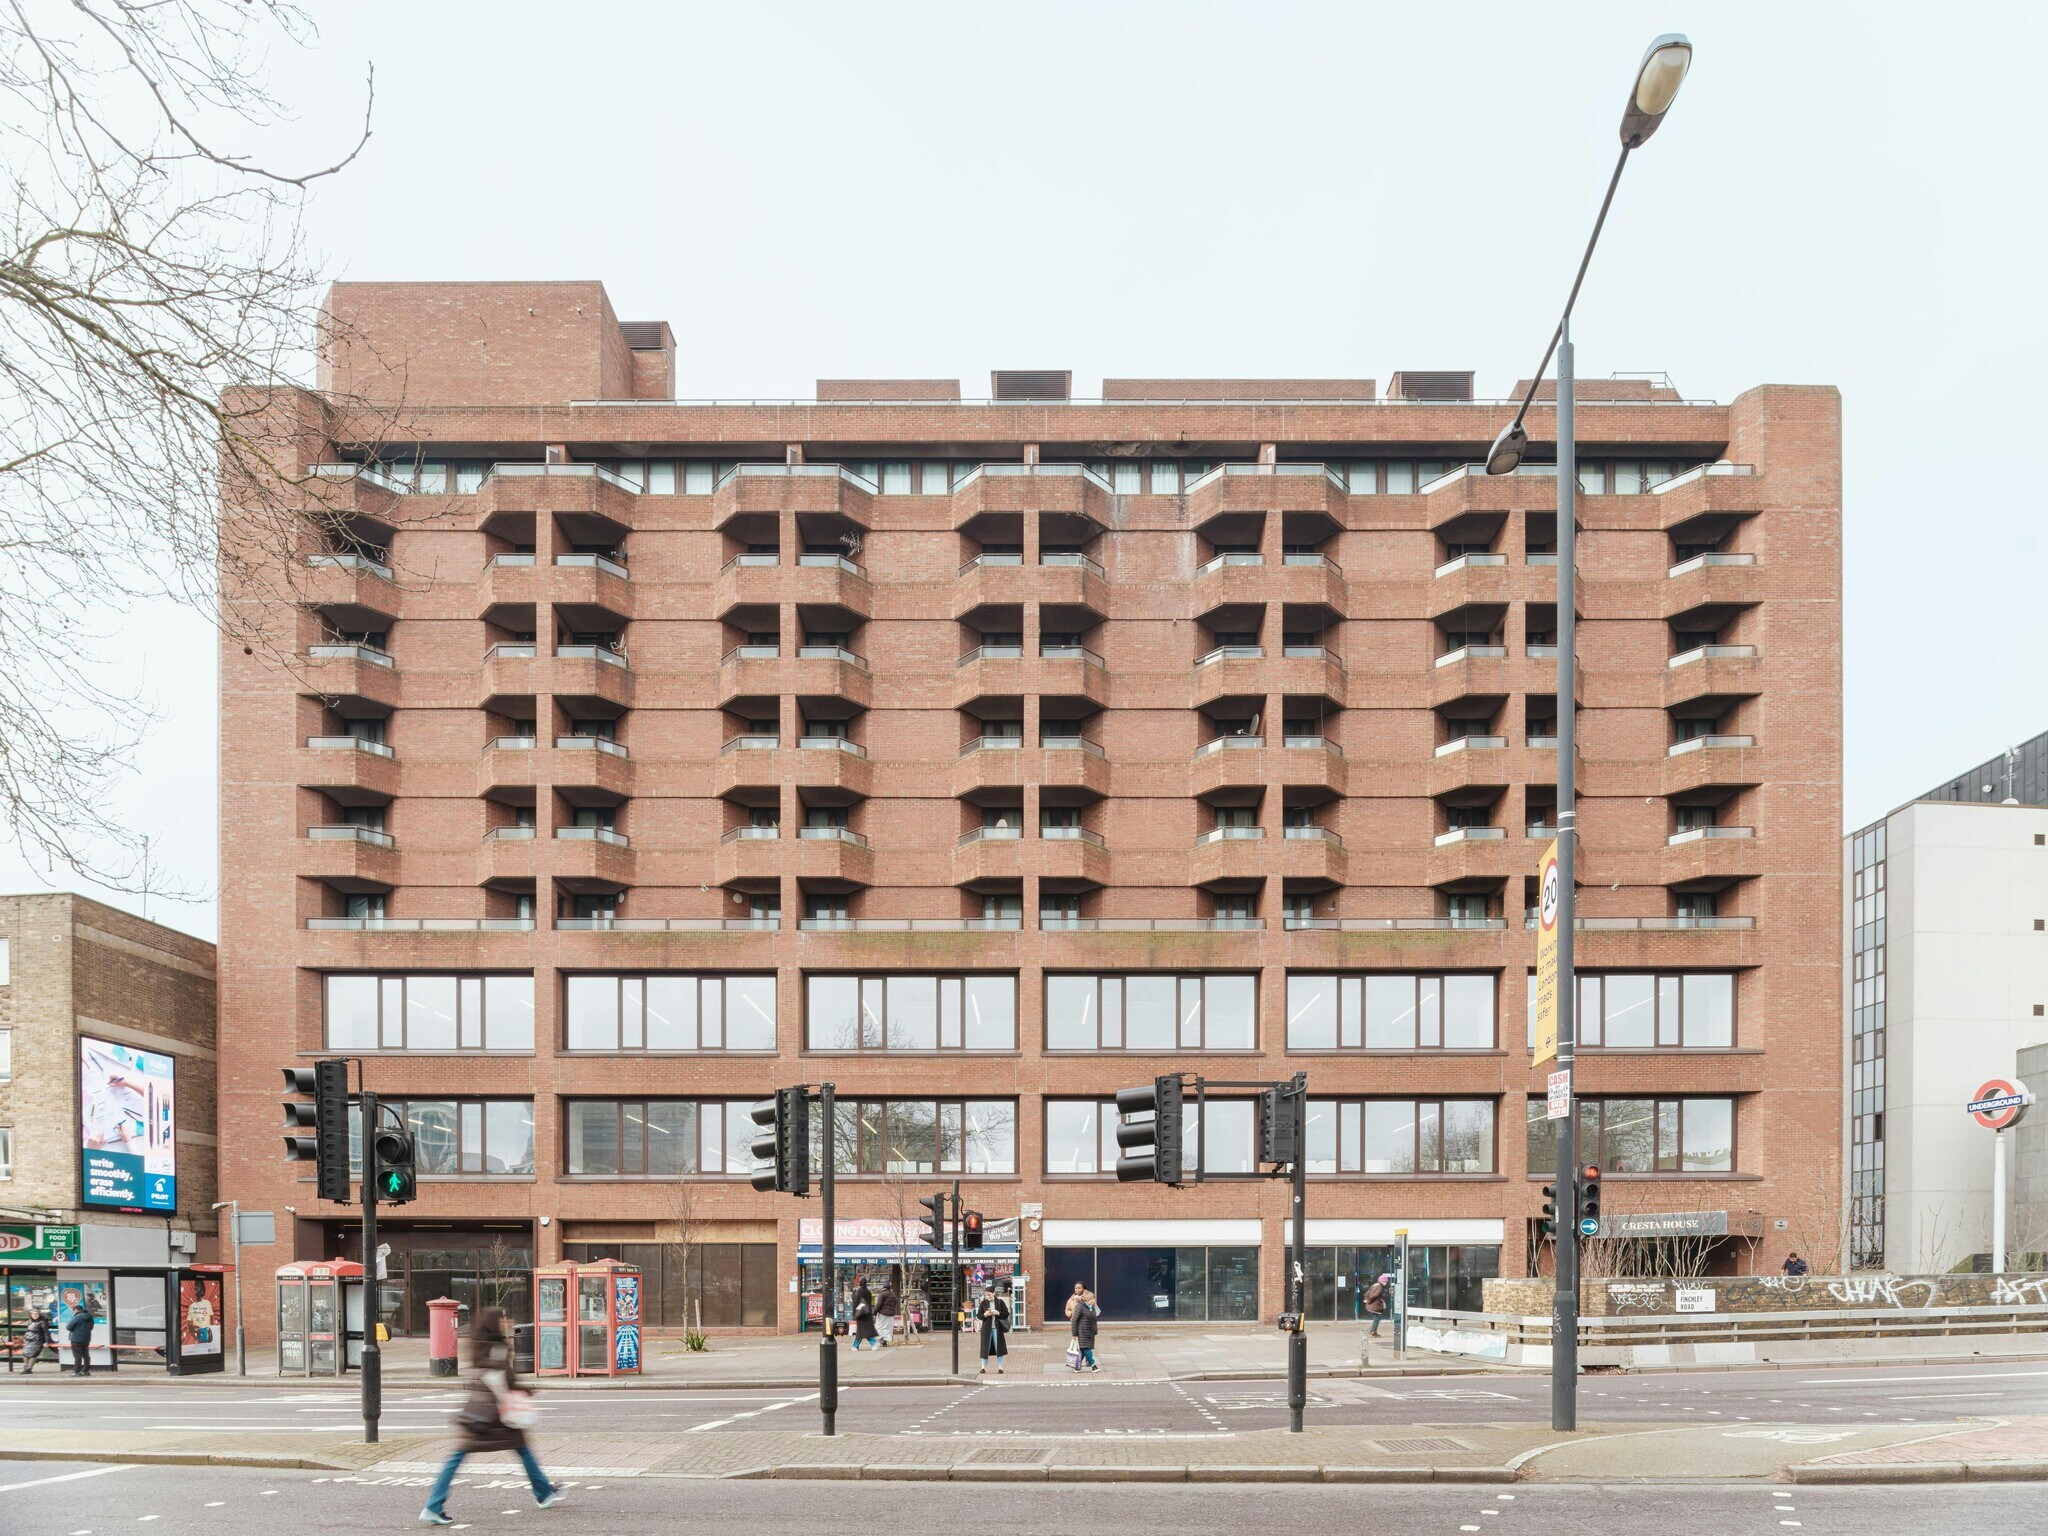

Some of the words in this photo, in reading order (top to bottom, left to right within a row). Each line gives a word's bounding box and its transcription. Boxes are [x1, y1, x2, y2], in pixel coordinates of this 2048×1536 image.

[1544, 877, 1557, 912] 20
[1540, 940, 1557, 959] Workin
[1538, 990, 1553, 1006] roads
[1537, 1006, 1551, 1022] safer
[1549, 1072, 1568, 1086] CASH
[1969, 1096, 2021, 1111] UNDERGROUND
[90, 1158, 114, 1169] write
[90, 1168, 134, 1181] smoothly,
[90, 1178, 114, 1188] erase
[90, 1186, 135, 1201] efficiently.
[151, 1193, 169, 1201] PILOT
[802, 1225, 857, 1237] CLOING
[1622, 1221, 1661, 1231] CRESTA
[1663, 1219, 1699, 1230] HOUSE
[1003, 1228, 1017, 1238] Now!
[996, 1266, 1013, 1274] SALE
[808, 1307, 822, 1315] SAL
